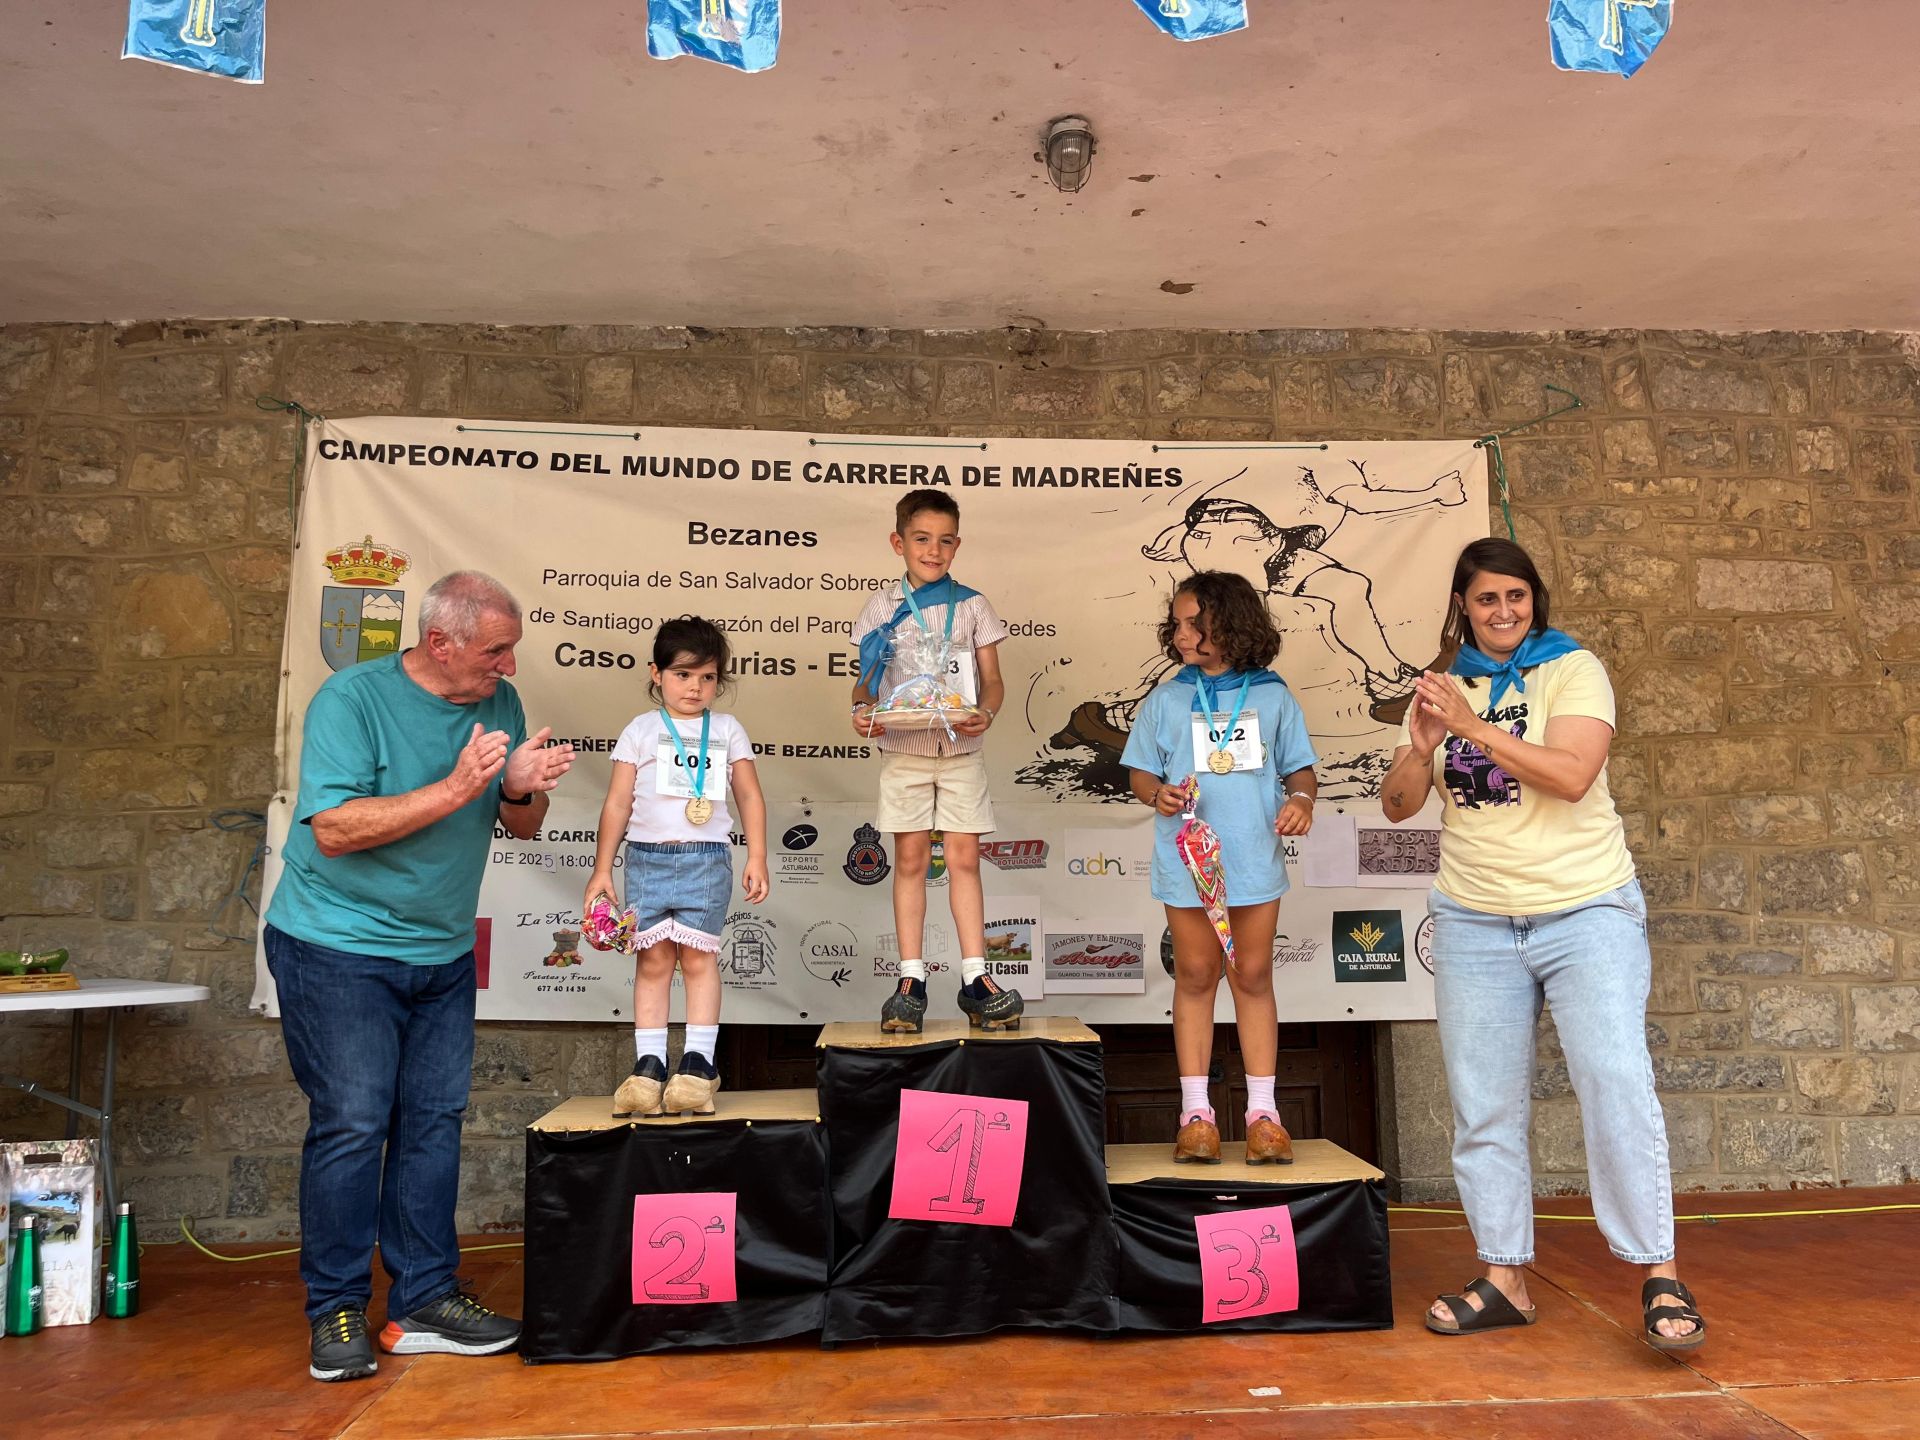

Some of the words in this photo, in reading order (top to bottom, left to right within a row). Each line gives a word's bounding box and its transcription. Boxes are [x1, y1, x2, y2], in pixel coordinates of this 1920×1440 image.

[318, 438, 539, 470] CAMPEONATO
[549, 451, 611, 475] DEL
[621, 455, 741, 481] MUNDO
[751, 459, 792, 482] DE
[802, 461, 952, 487] CARRERA
[961, 465, 1001, 487] DE
[1011, 462, 1184, 489] MADREÑES
[687, 520, 818, 548] Bezanes
[543, 568, 640, 591] Parroquia
[647, 570, 672, 588] de
[678, 571, 718, 589] San
[725, 573, 814, 591] Salvador
[529, 607, 556, 624] de
[562, 609, 654, 635] Santiago
[680, 613, 763, 634] azón
[774, 616, 799, 633] del
[806, 617, 858, 639] Parq
[554, 642, 637, 670] Caso
[751, 743, 776, 756] DE
[782, 744, 871, 759] BEZANES
[1359, 831, 1379, 846] LA
[1383, 830, 1440, 846] POSAD
[1392, 845, 1417, 858] DE
[492, 851, 515, 865] DE
[518, 852, 554, 868] 2025
[559, 854, 596, 868] 18:00
[1376, 858, 1441, 873] REDES
[781, 864, 819, 872] ASTURIANO
[517, 912, 540, 927] La
[1051, 935, 1086, 951] JAMONES
[1088, 934, 1094, 942] Y
[1096, 934, 1143, 951] EMBUTIDOS
[811, 944, 858, 957] CASAL
[1337, 953, 1364, 963] CAJA
[1366, 952, 1401, 963] RURAL
[523, 970, 560, 980] Patatas
[570, 972, 602, 981] Frutas
[995, 961, 1029, 975] Casín
[576, 985, 586, 993] 38
